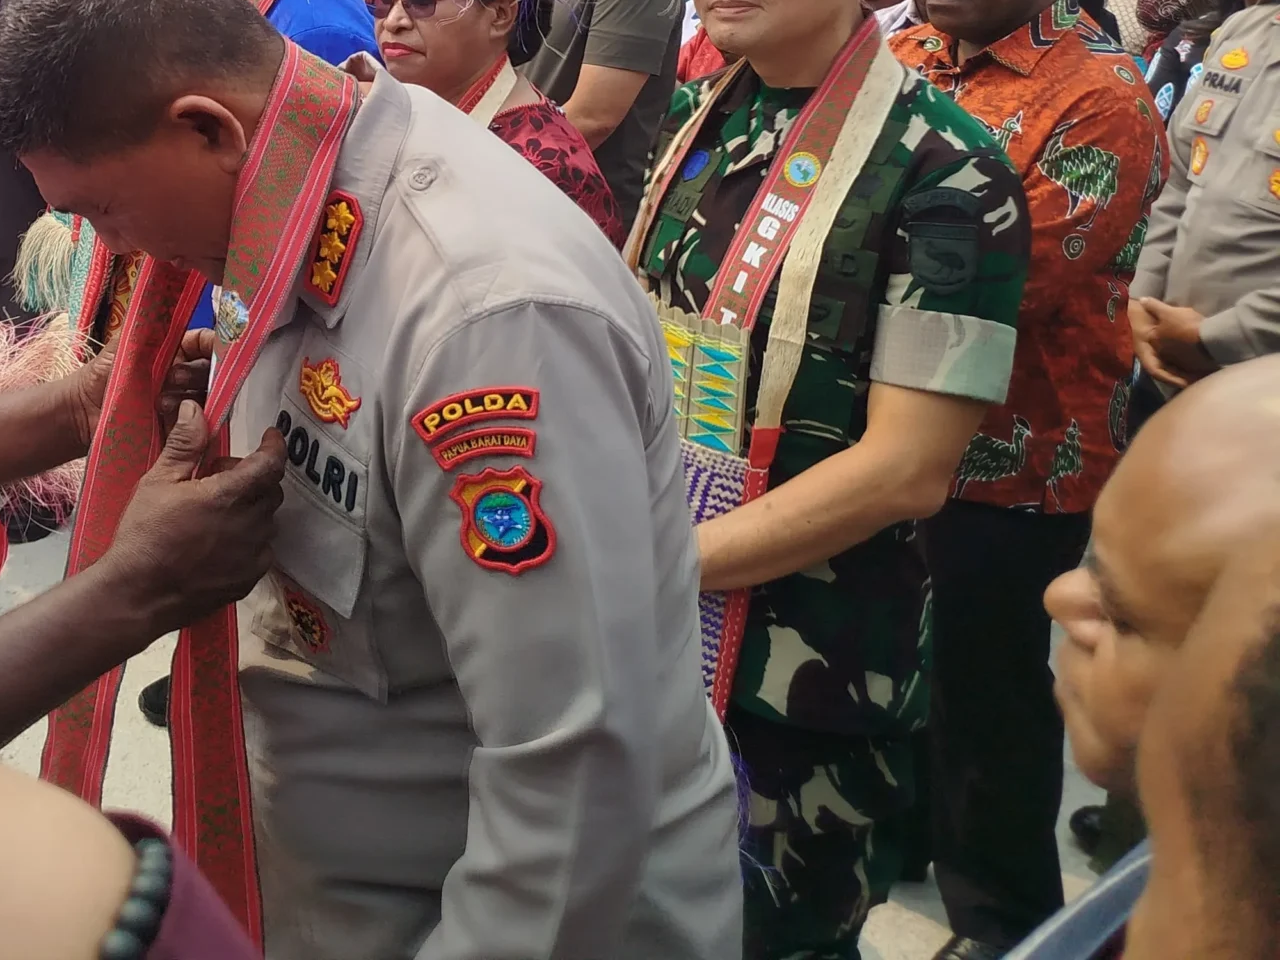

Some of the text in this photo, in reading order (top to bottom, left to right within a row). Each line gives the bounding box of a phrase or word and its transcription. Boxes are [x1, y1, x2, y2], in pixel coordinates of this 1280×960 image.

[1202, 71, 1243, 94] PRAJA
[761, 192, 799, 222] KLASIS
[423, 393, 528, 435] POLDA
[276, 410, 359, 512] POLRI
[441, 434, 527, 462] PAPUA BARAT DAYA
